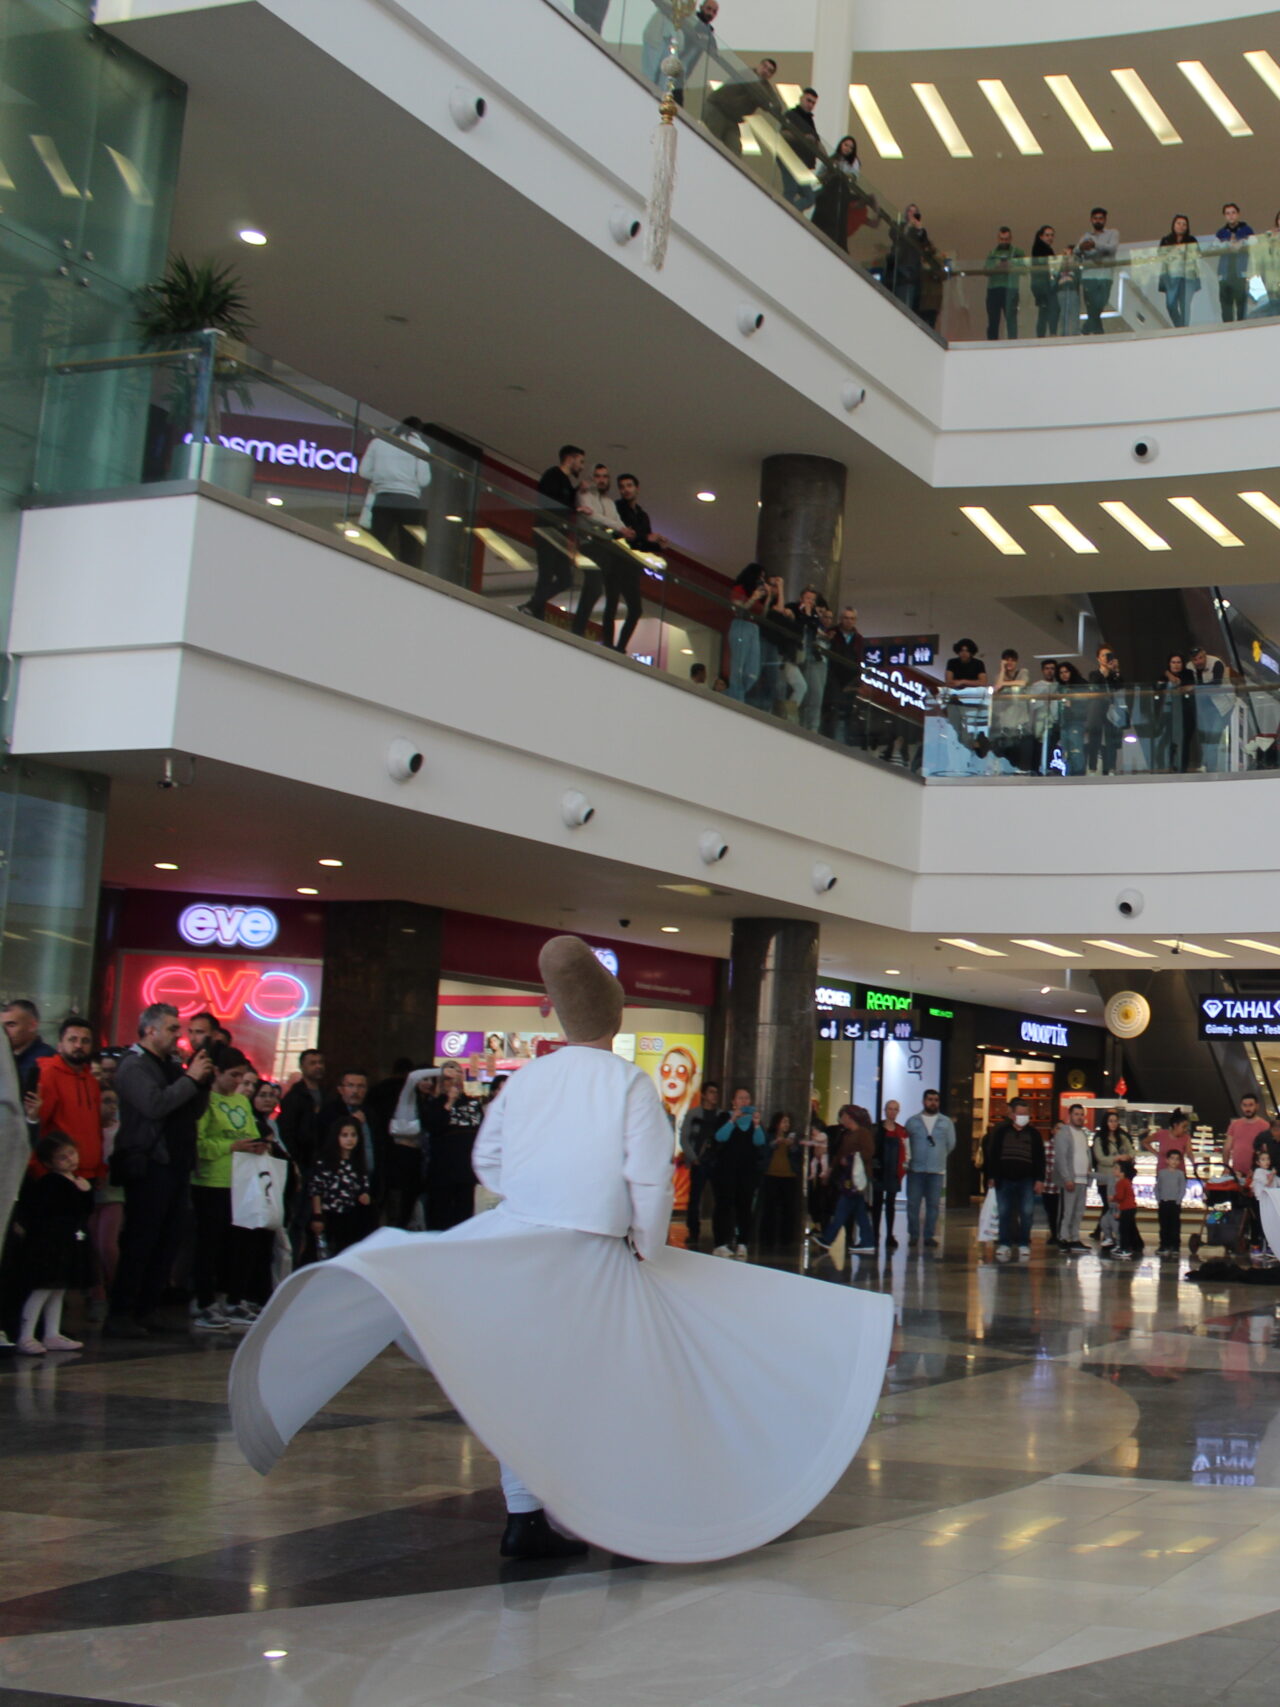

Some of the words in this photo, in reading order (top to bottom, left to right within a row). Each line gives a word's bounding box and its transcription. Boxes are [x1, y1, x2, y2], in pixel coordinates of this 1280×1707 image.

[184, 433, 357, 474] smetica
[180, 903, 277, 947] eve
[142, 966, 309, 1022] eve
[1223, 1001, 1275, 1018] TAHAL
[1238, 1024, 1258, 1035] Saat
